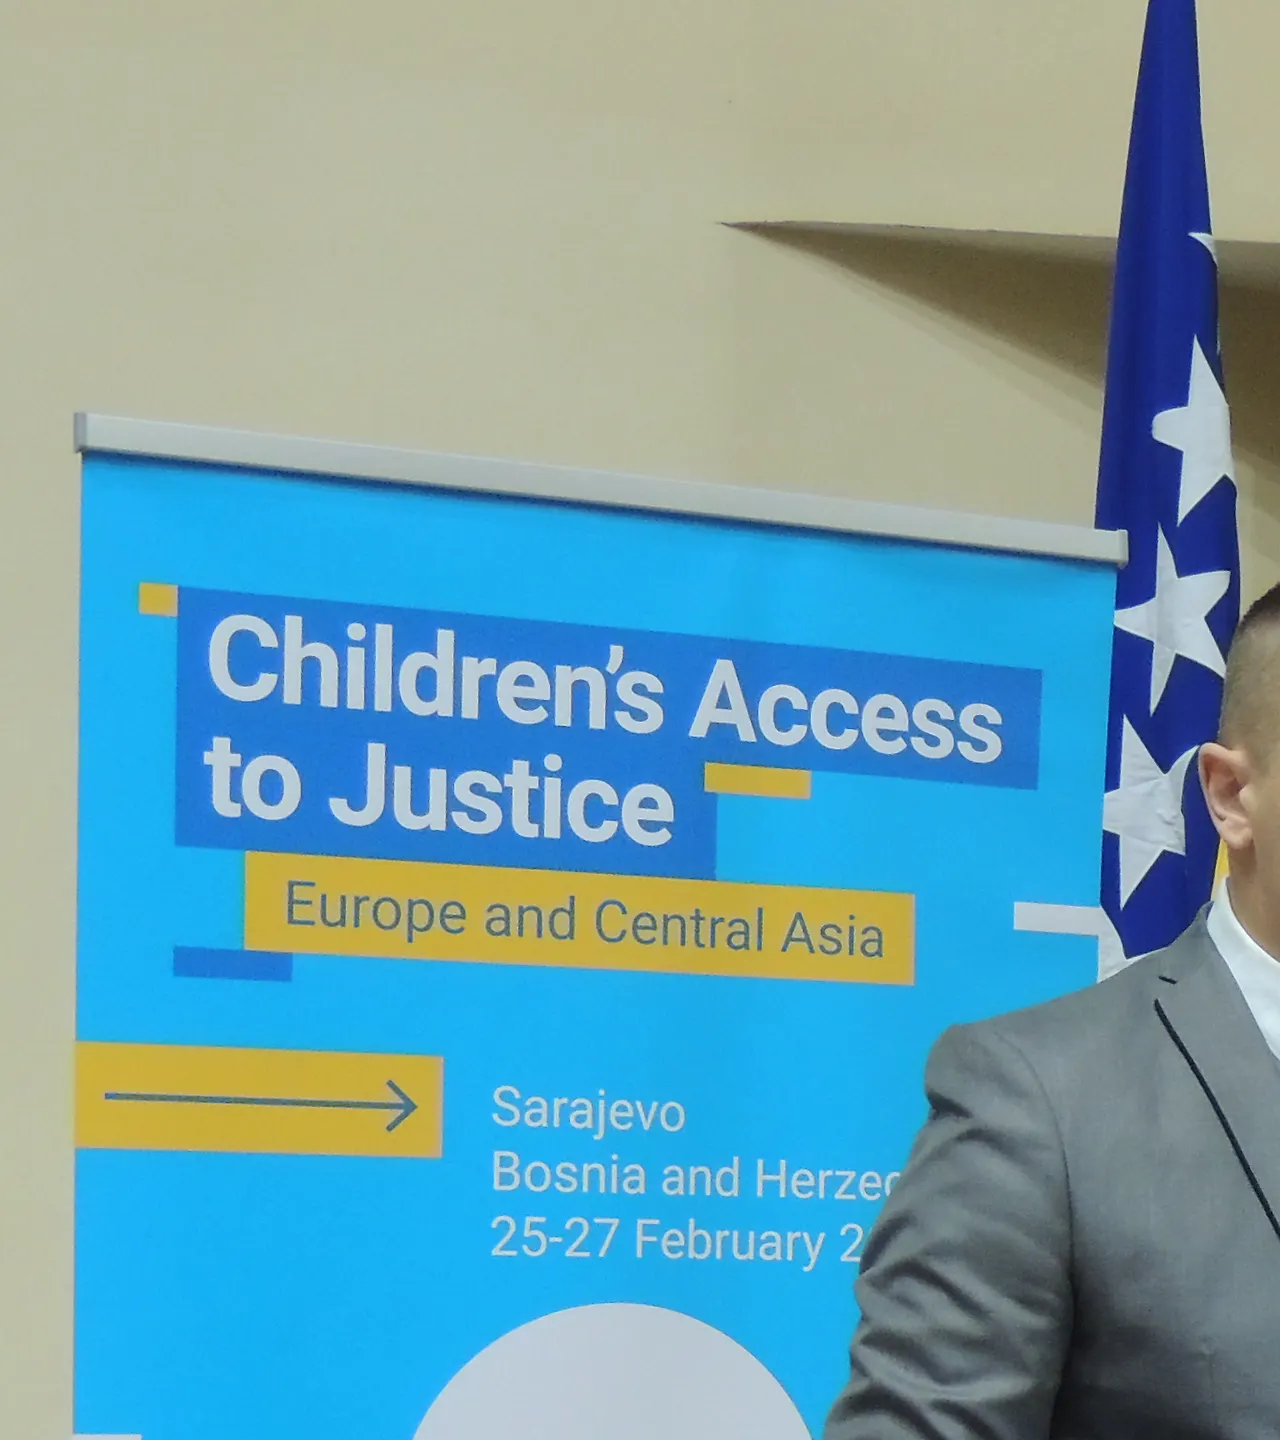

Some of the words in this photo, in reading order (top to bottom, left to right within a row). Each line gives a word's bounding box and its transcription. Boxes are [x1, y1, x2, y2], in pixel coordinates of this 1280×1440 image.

[689, 657, 1004, 765] Access
[203, 736, 301, 820] to
[329, 743, 675, 847] Justice
[285, 881, 466, 941] Europe
[485, 894, 577, 943] and
[595, 899, 765, 952] Central
[780, 913, 885, 957] Asia
[492, 1085, 686, 1140] Sarajevo
[492, 1151, 646, 1194] Bosnia
[662, 1156, 740, 1197] and
[491, 1215, 620, 1257] 25-27
[635, 1218, 826, 1272] February
